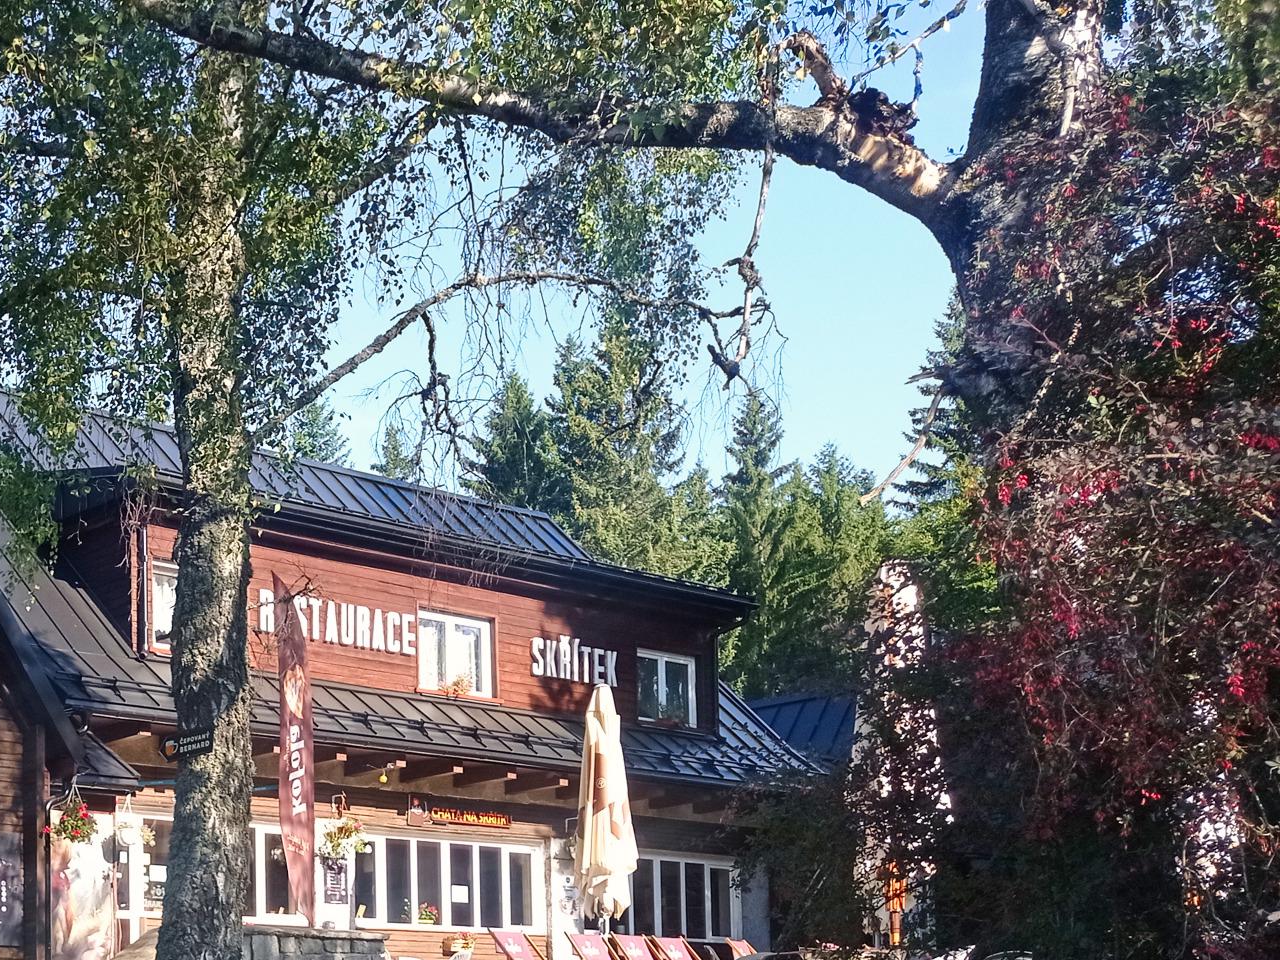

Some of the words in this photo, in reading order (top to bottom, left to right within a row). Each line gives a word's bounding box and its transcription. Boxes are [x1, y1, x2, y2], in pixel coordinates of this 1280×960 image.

[259, 588, 417, 656] RSTAURACE
[530, 634, 618, 687] SKŘÍTEK
[179, 741, 210, 753] BERNARD
[431, 807, 462, 821] CHATA
